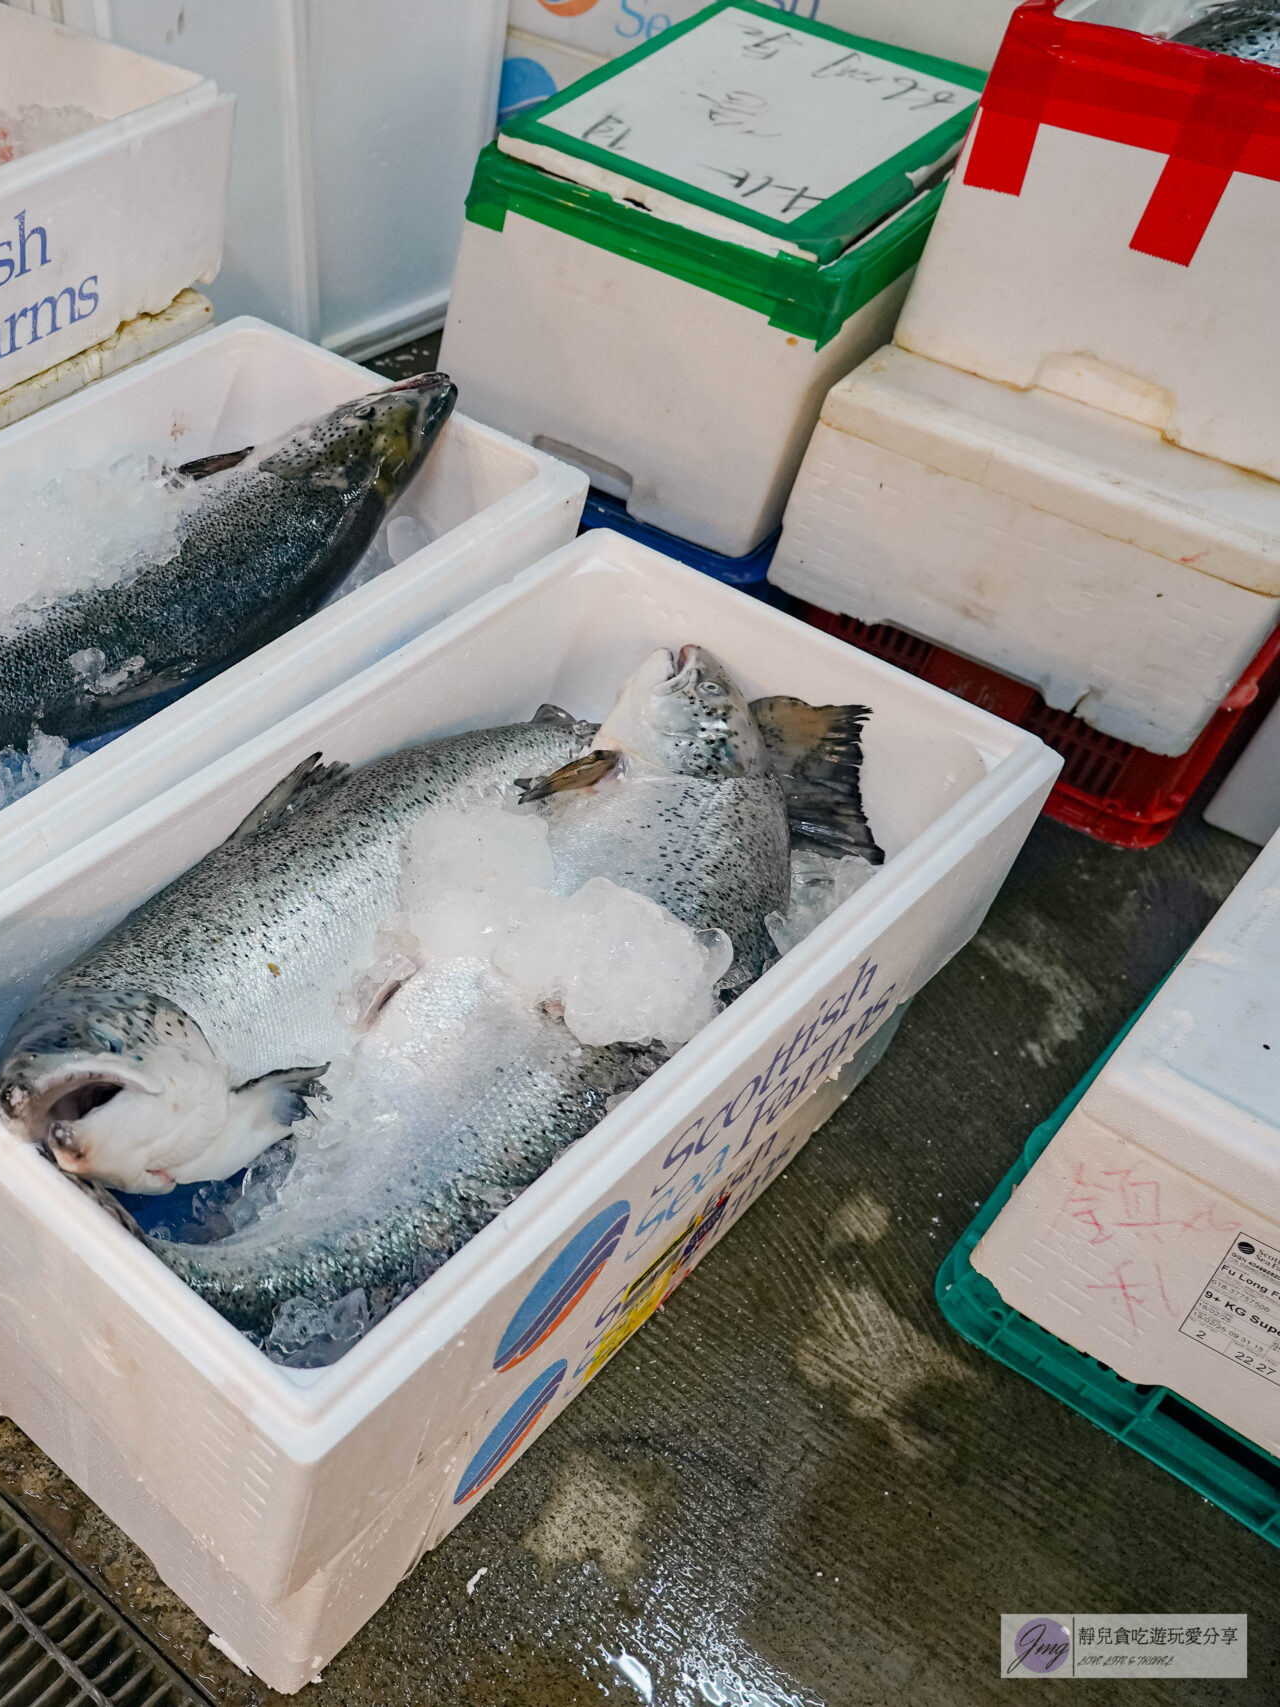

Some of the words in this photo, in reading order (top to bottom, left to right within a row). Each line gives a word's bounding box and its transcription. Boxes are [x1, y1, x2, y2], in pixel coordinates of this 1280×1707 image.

[651, 956, 879, 1197] Scottish
[625, 1144, 731, 1263] Sea
[732, 983, 895, 1159] Farms
[1221, 1264, 1236, 1276] Fu
[1239, 1273, 1268, 1294] Long
[1204, 1290, 1220, 1302] 9+
[1224, 1301, 1247, 1316] KG
[1195, 1330, 1206, 1340] 2
[1234, 1351, 1277, 1375] 22.27
